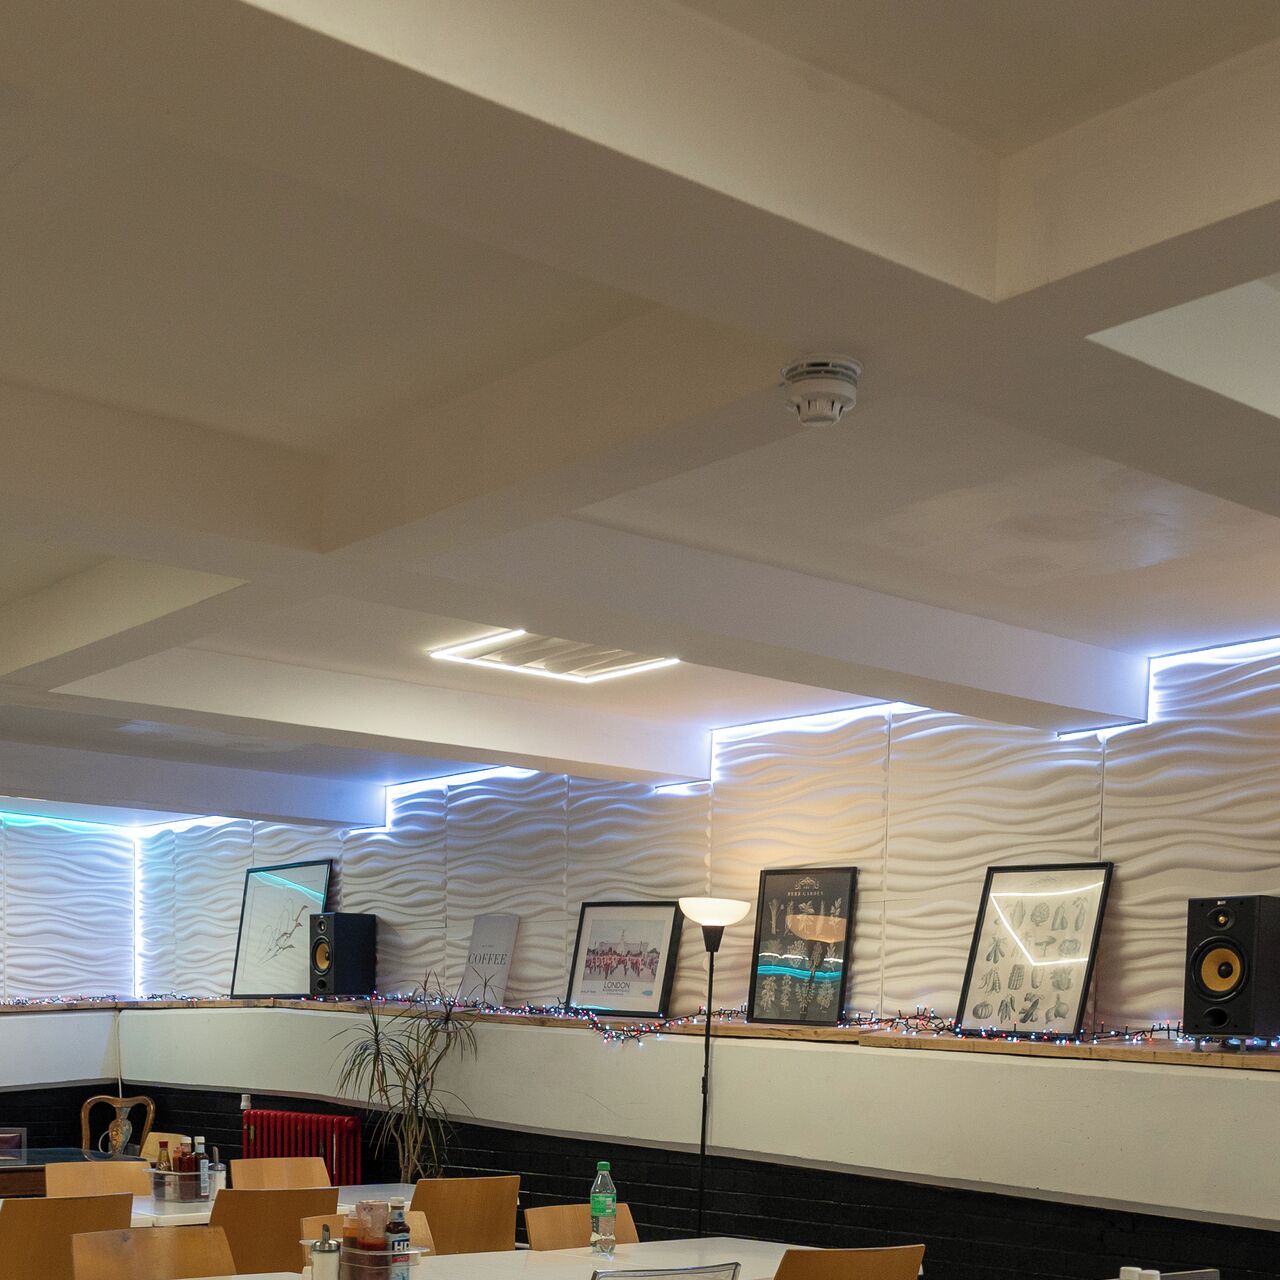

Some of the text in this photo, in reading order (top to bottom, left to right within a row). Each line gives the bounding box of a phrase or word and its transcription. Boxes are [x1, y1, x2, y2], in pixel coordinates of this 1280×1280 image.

[467, 953, 507, 965] COFFEE
[603, 981, 630, 989] LONDON
[395, 1241, 410, 1251] HP
